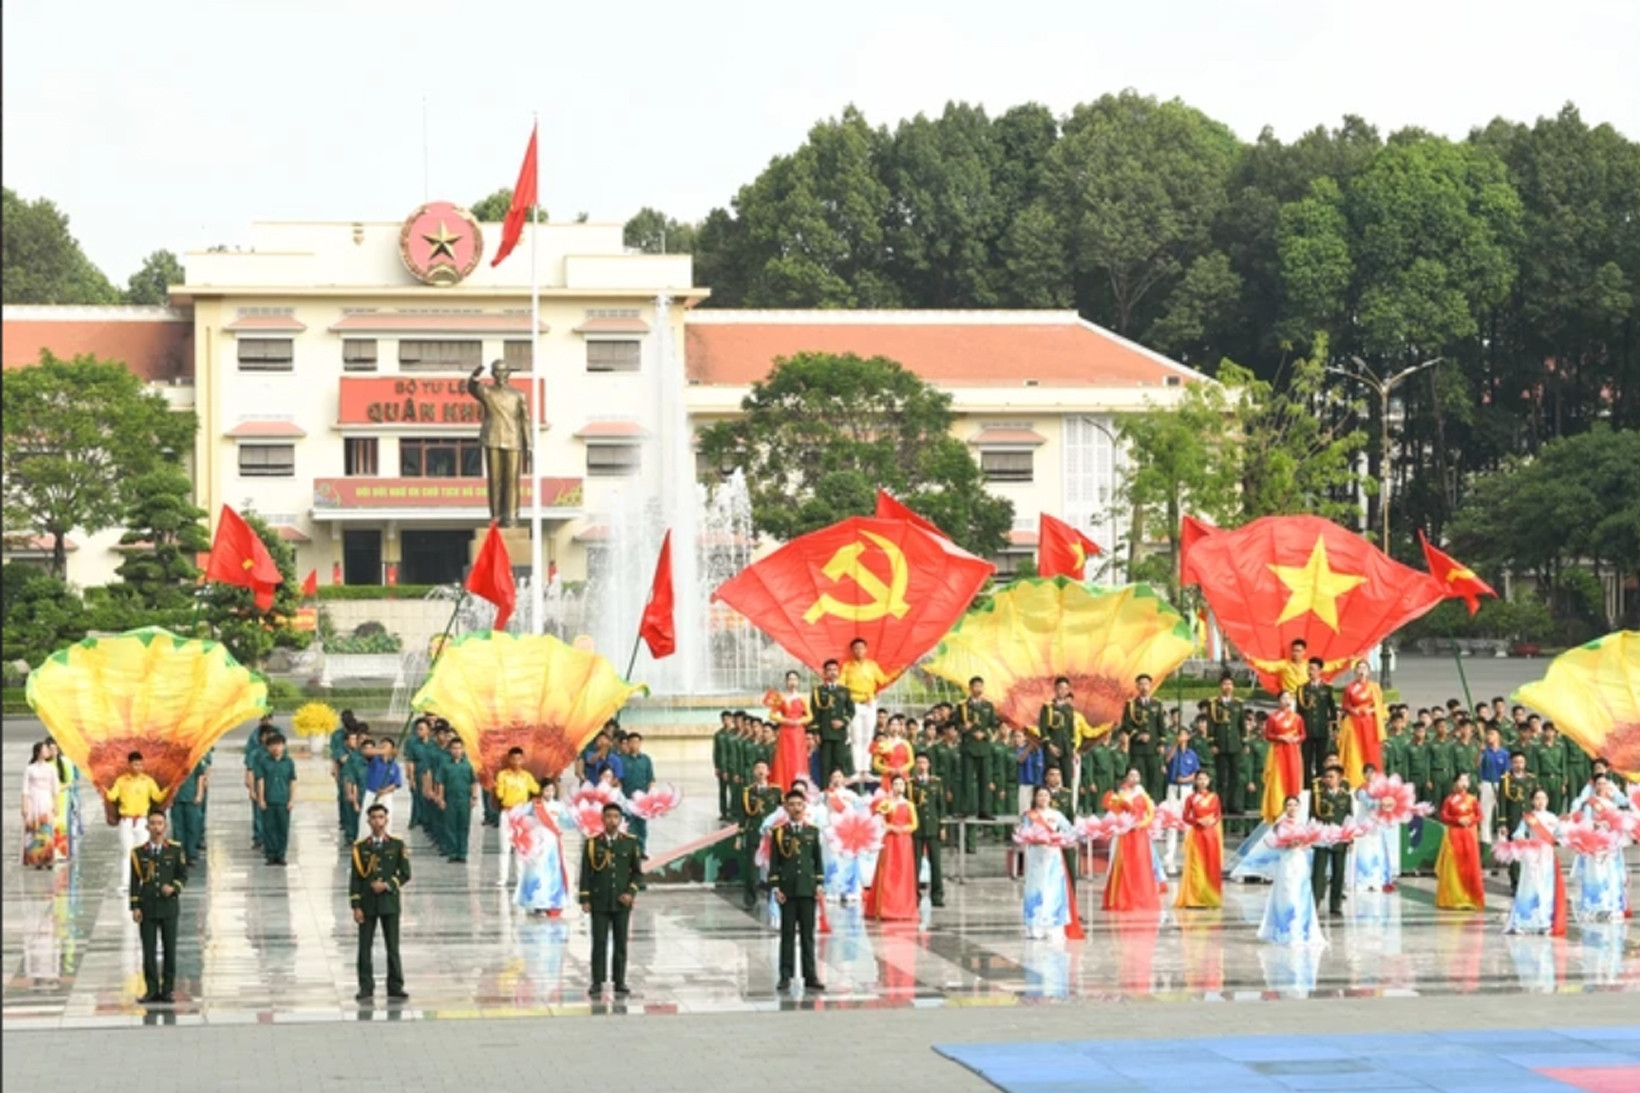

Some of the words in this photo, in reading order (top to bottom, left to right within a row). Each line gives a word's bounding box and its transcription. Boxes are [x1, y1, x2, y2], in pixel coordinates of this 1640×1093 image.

[395, 379, 416, 395] BỘ
[423, 380, 444, 394] TƯ
[448, 379, 468, 396] LỆ
[367, 397, 436, 422] QUÂN
